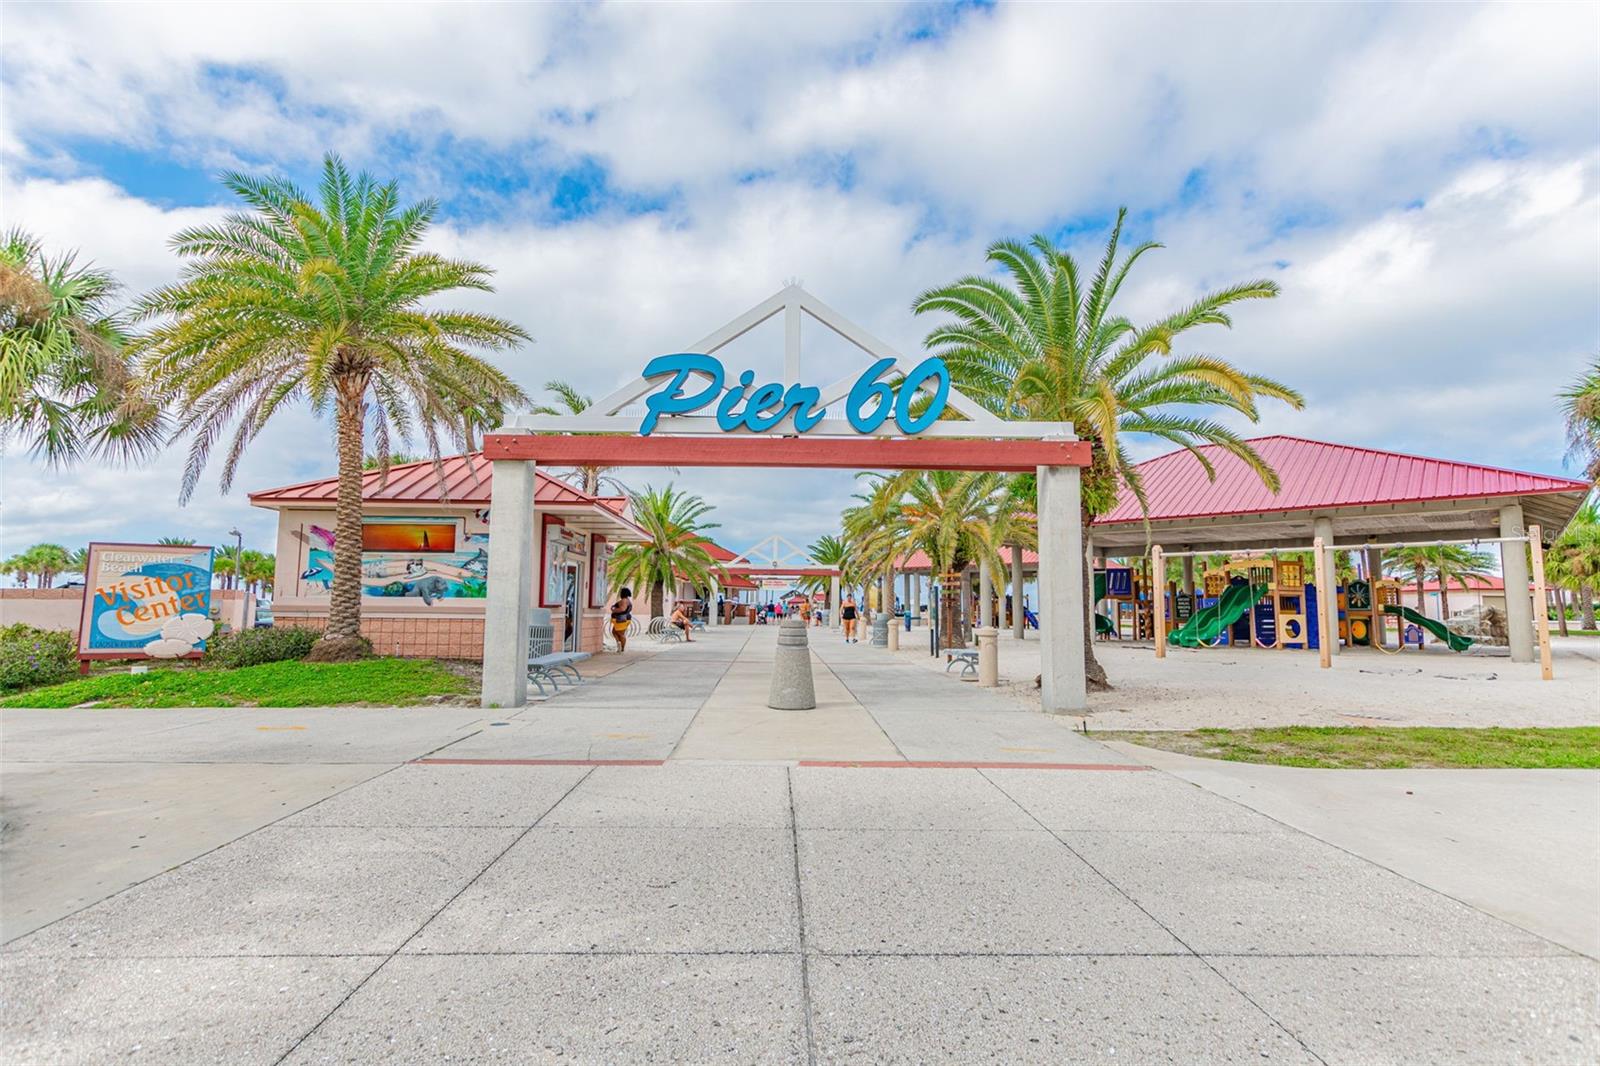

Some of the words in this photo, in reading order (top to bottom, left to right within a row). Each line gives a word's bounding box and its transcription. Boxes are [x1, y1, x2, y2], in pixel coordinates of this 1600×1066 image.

[639, 353, 827, 436] Pier
[846, 357, 951, 435] 60
[102, 552, 174, 563] Clearwater
[102, 561, 143, 573] Beach
[96, 571, 194, 606] Visitor
[116, 592, 206, 625] Center
